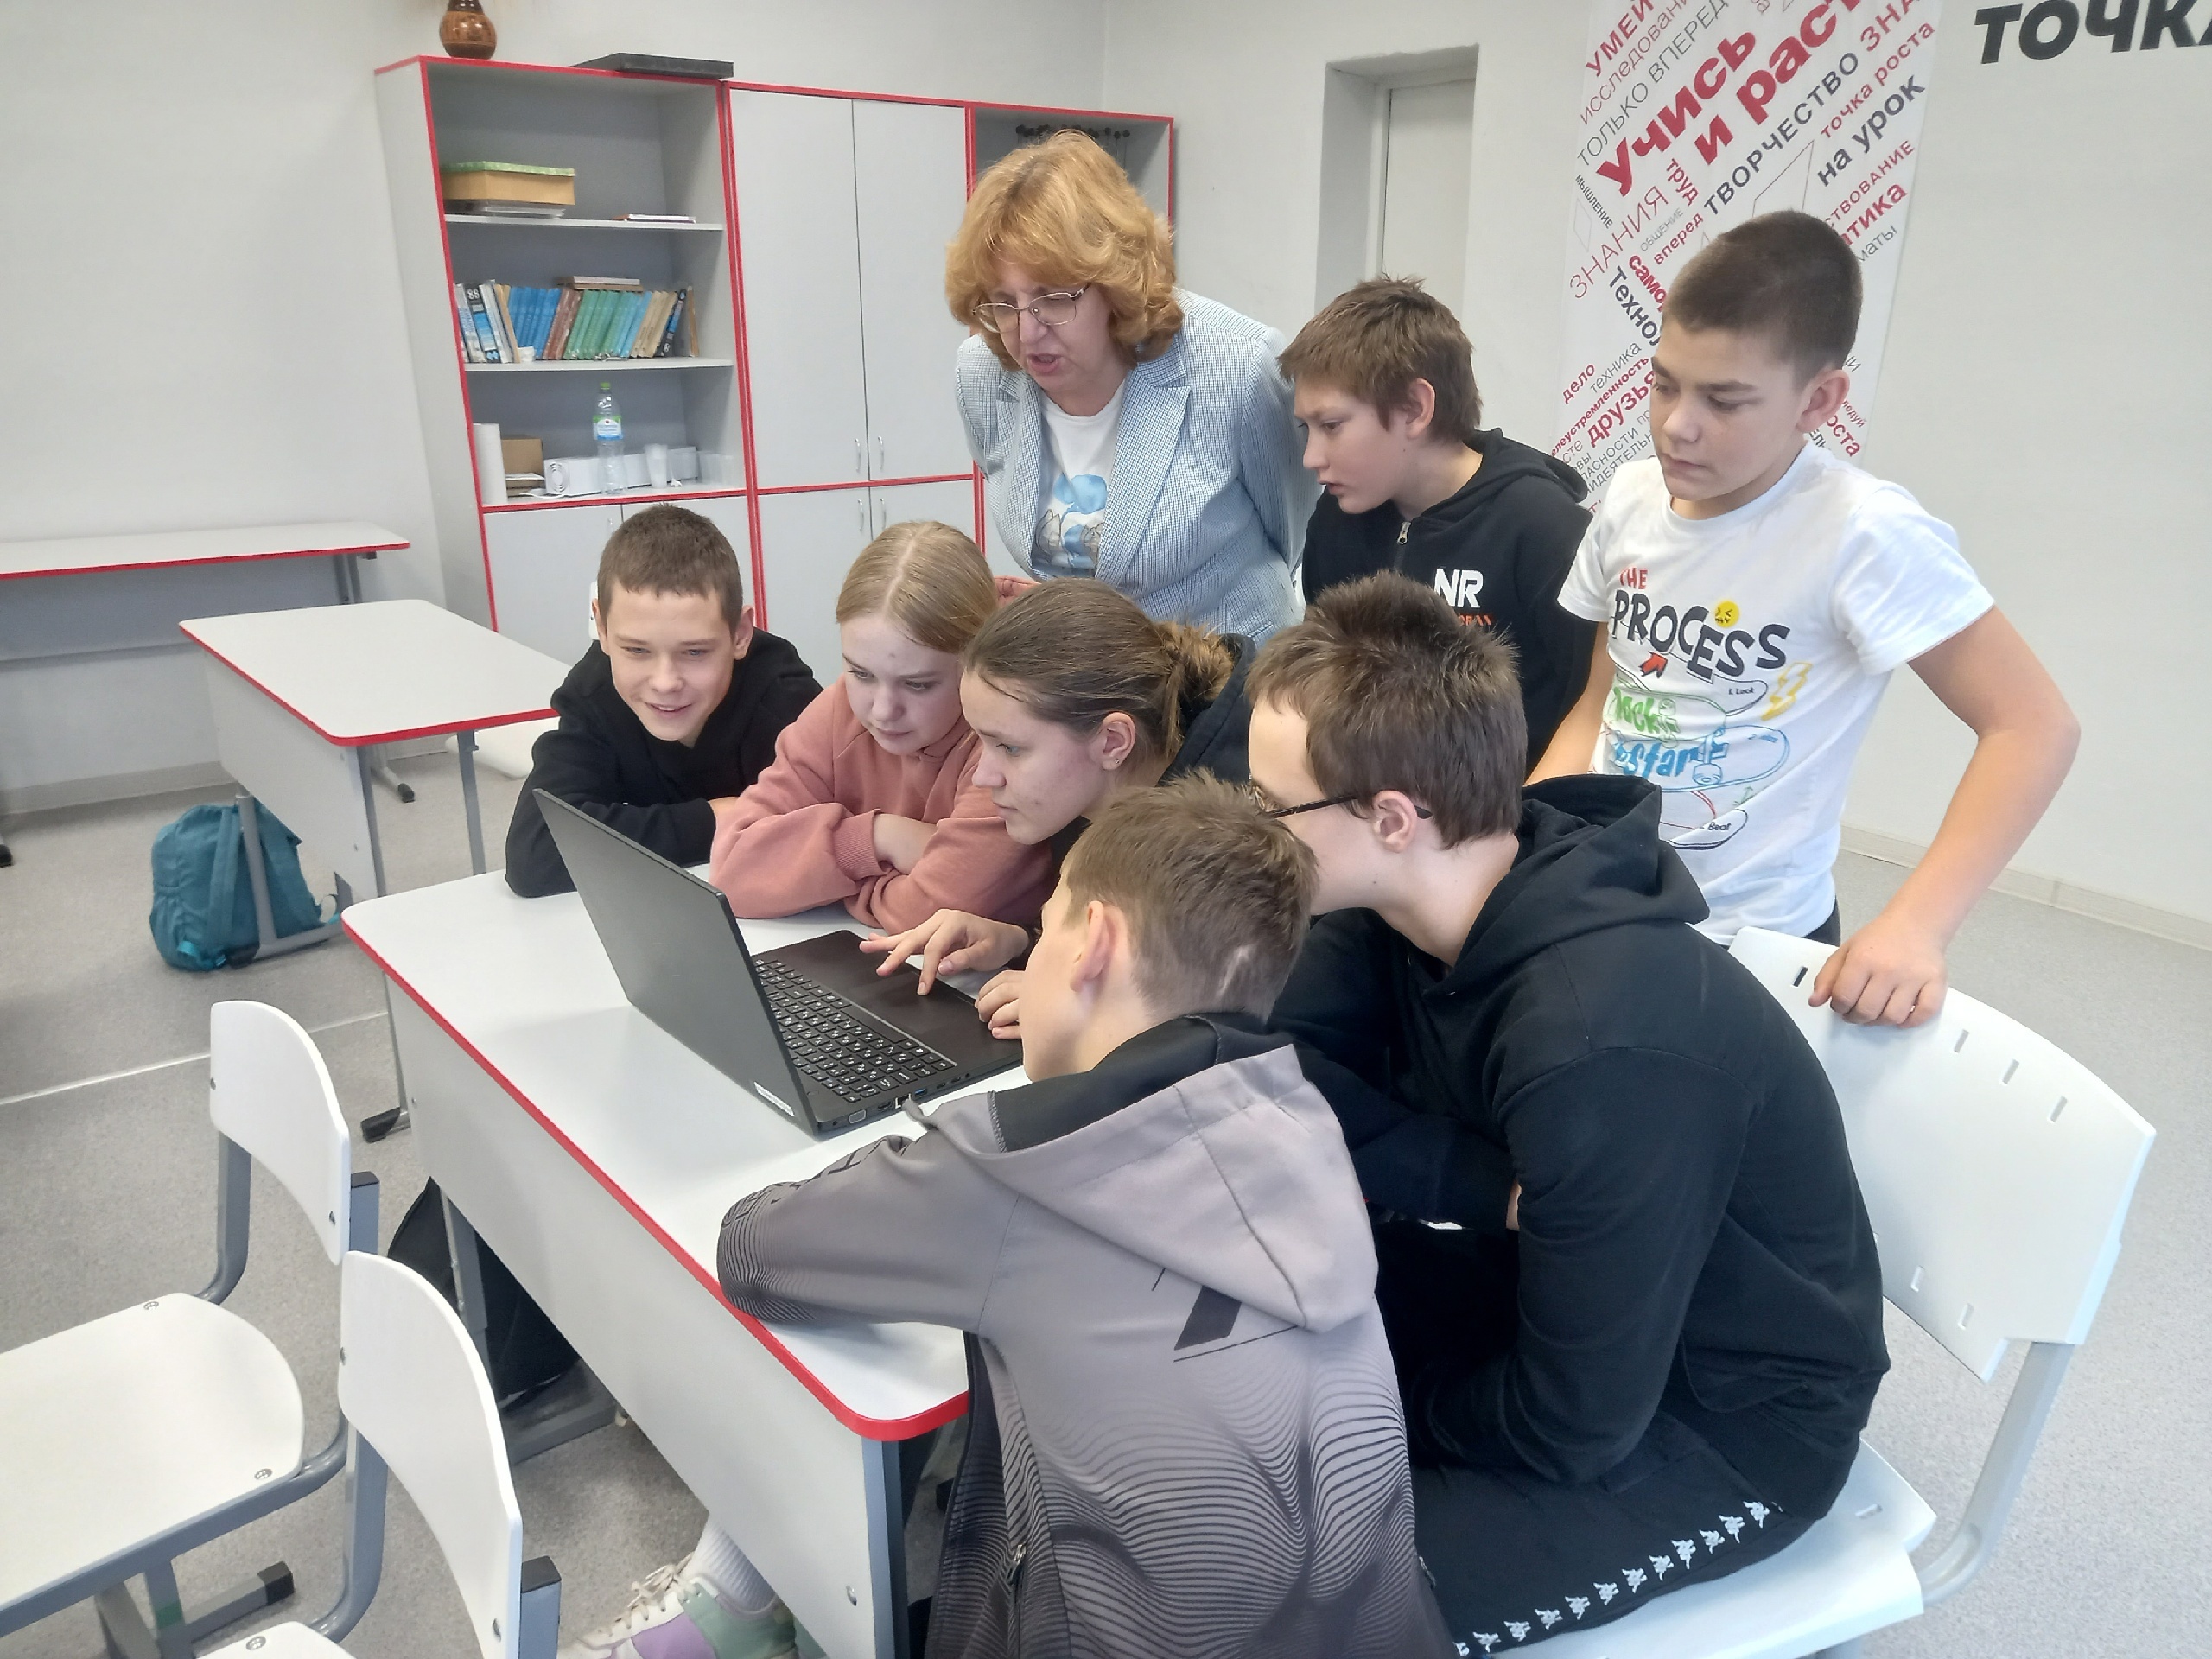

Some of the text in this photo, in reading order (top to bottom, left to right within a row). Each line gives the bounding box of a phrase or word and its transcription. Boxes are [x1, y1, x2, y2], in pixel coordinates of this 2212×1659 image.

[1580, 0, 1689, 125] исследован
[1974, 0, 2212, 64] ТОЧК
[1596, 32, 1756, 197] Учись
[1694, 0, 1860, 165] и рас
[1821, 23, 1935, 138] точка роста
[1577, 83, 1648, 166] ТОЛЬКО
[1704, 53, 1858, 214] ТВОРЧЕСТВО
[1818, 75, 1925, 187] на урок
[1667, 158, 1699, 206] труд
[1570, 186, 1669, 298] ЗНАНИЯ
[1640, 207, 1684, 252] ОБЩЕНИЕ
[1654, 213, 1704, 265] вперед
[1629, 255, 1667, 313] само
[1562, 364, 1595, 404] дело
[1590, 342, 1643, 394] техника
[1434, 568, 1483, 608] NR
[1620, 567, 1649, 589] THE
[1611, 590, 1791, 683] PROCESS
